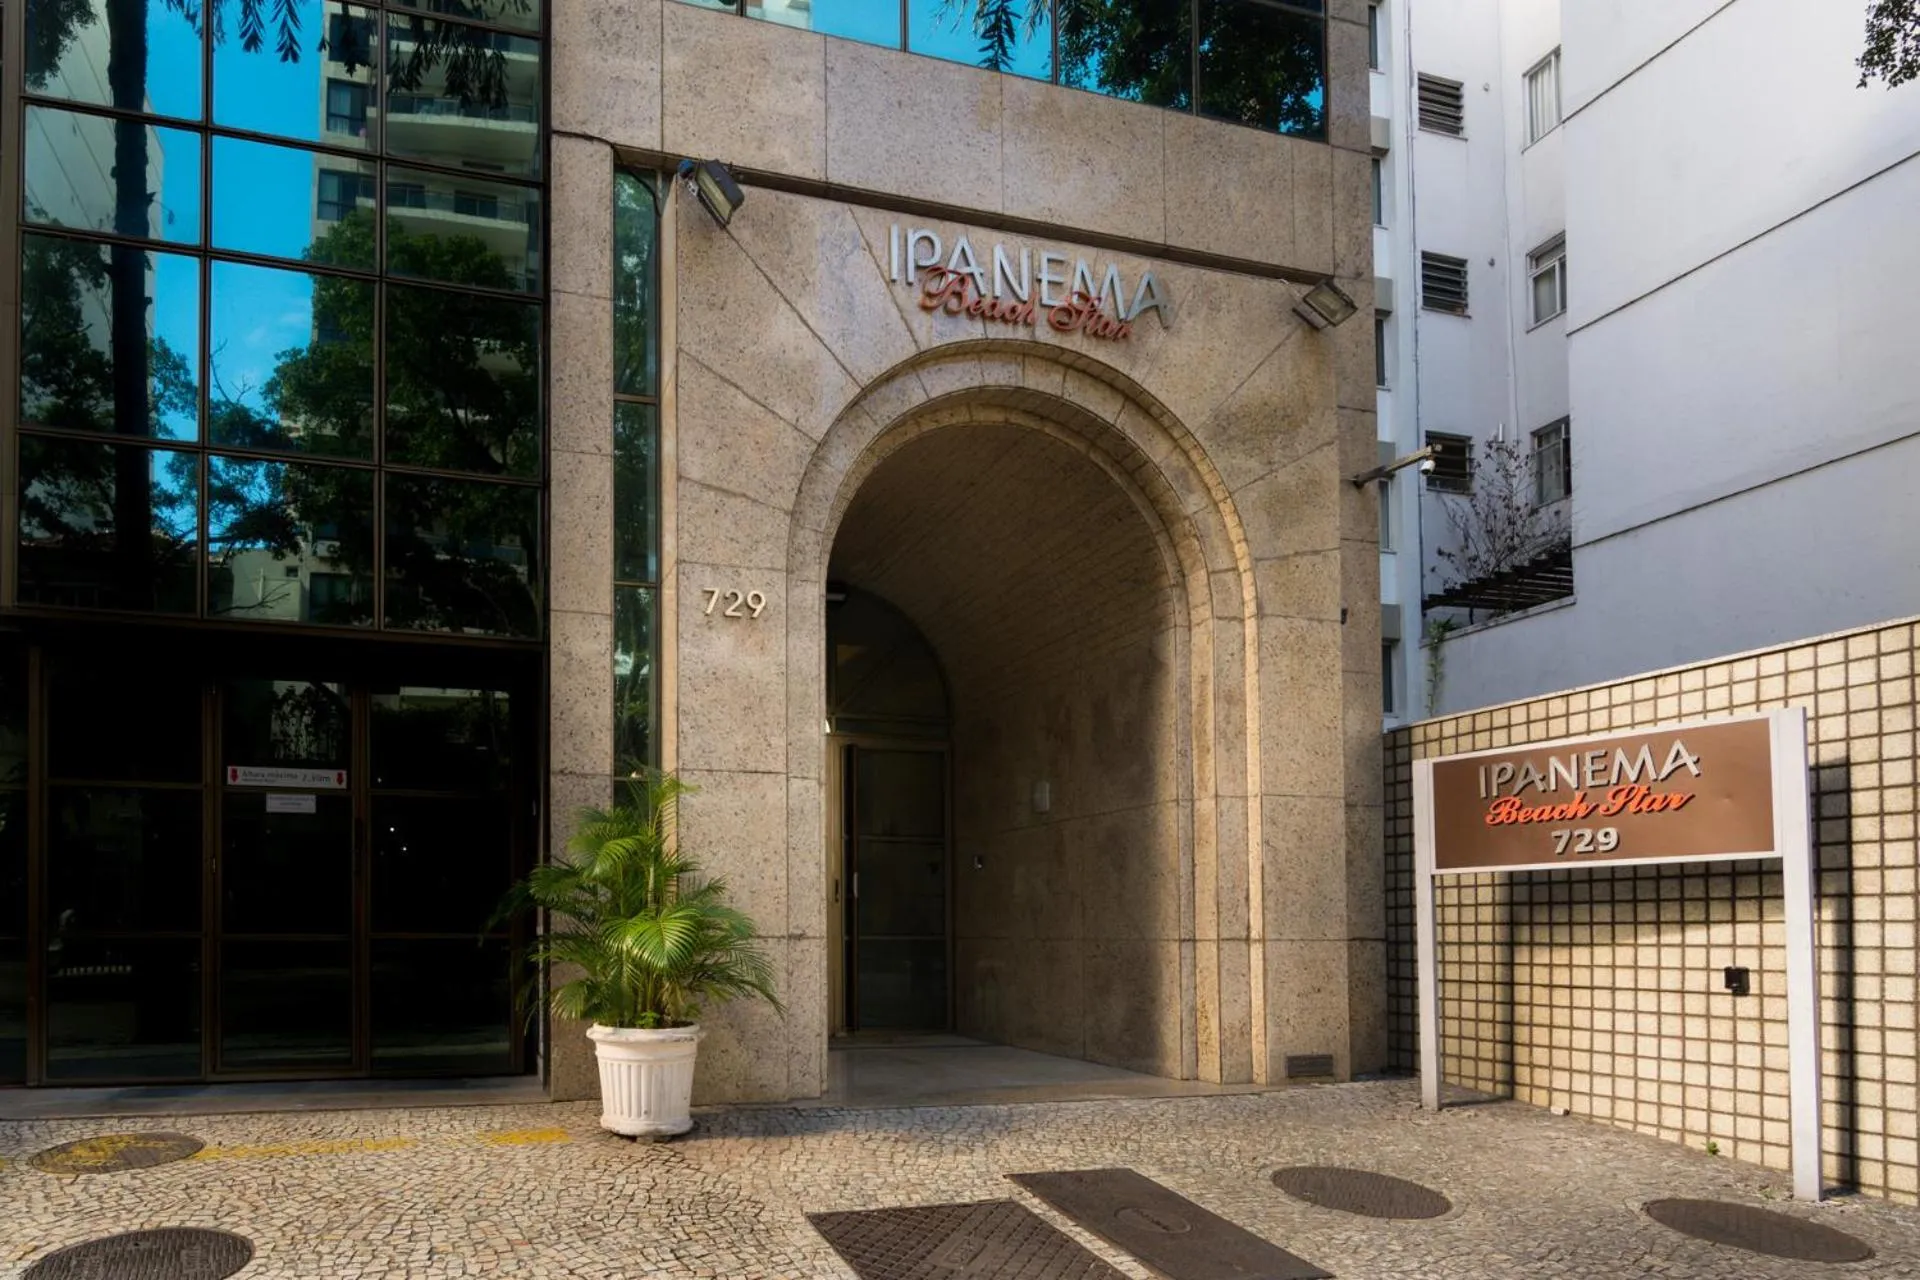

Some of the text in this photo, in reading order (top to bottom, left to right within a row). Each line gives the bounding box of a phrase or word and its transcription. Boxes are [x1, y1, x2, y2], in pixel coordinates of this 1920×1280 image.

[889, 223, 1172, 330] IPANEMA
[920, 266, 1133, 342] Beach Star
[702, 587, 766, 619] 729
[1478, 738, 1701, 800] IPANEMA
[1485, 783, 1696, 827] Beach Star
[1551, 826, 1620, 855] 729
